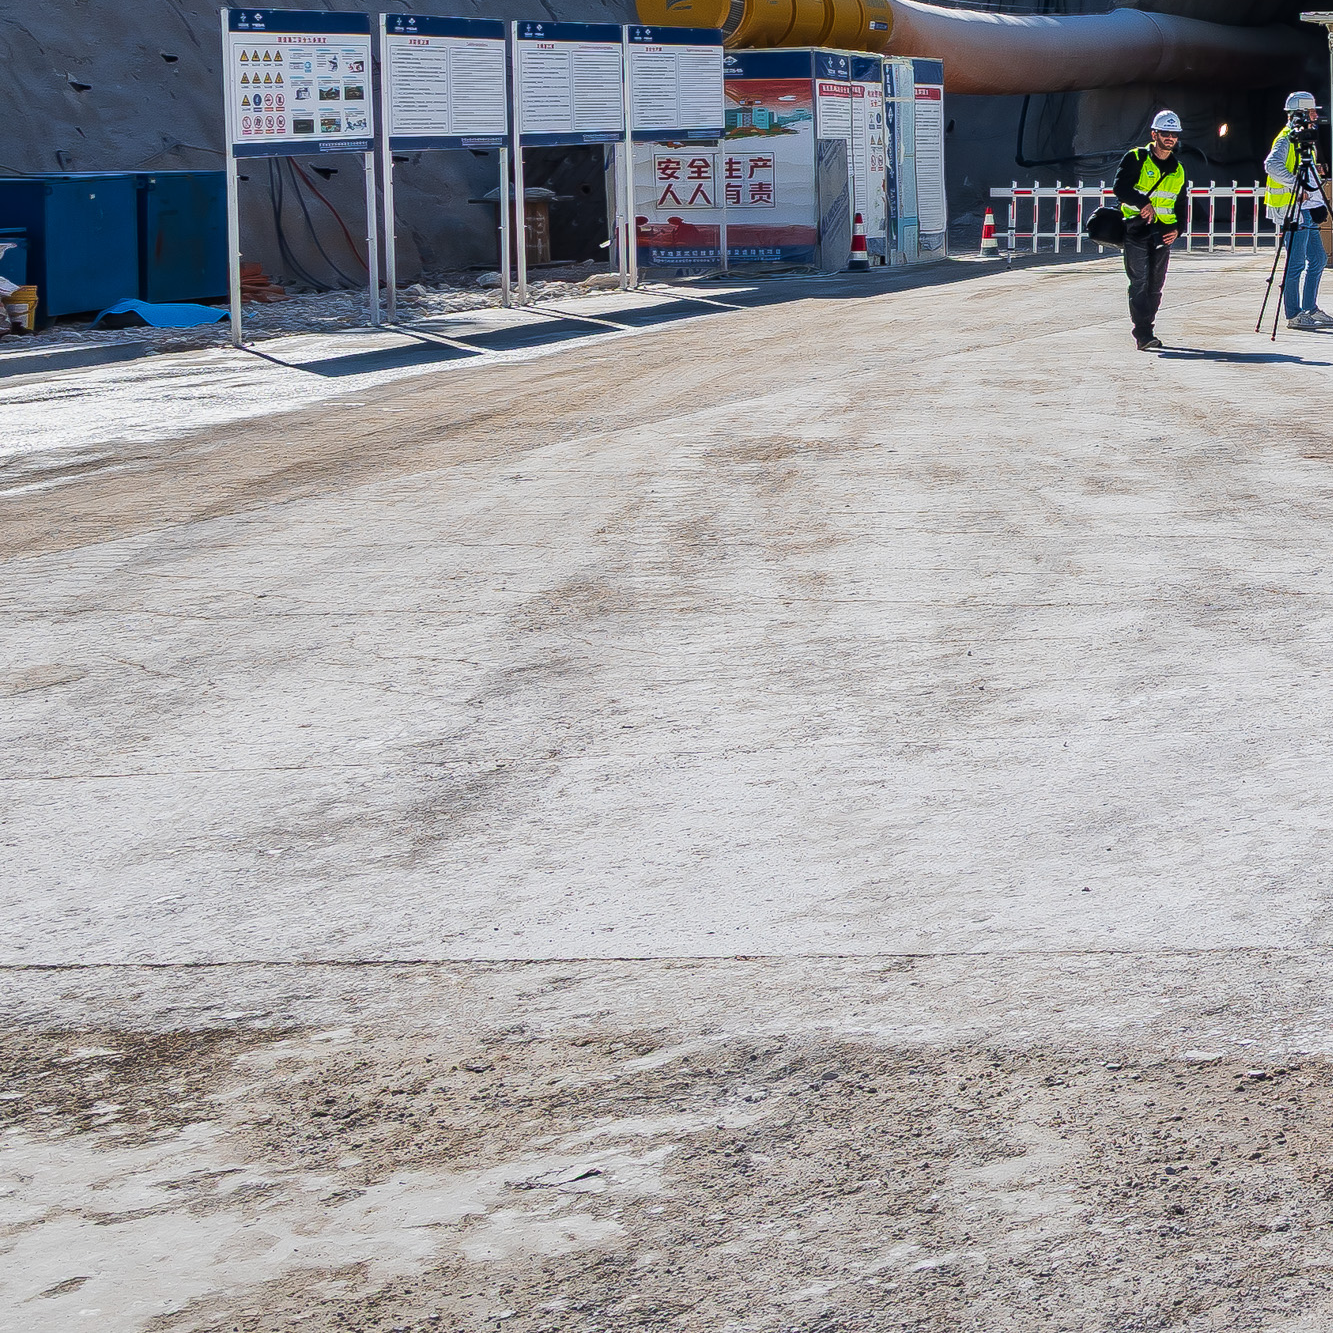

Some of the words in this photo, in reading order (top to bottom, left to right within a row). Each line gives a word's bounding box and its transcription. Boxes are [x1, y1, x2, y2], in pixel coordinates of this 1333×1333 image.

[657, 156, 773, 181] 安全生产
[657, 182, 774, 206] 人人有责
